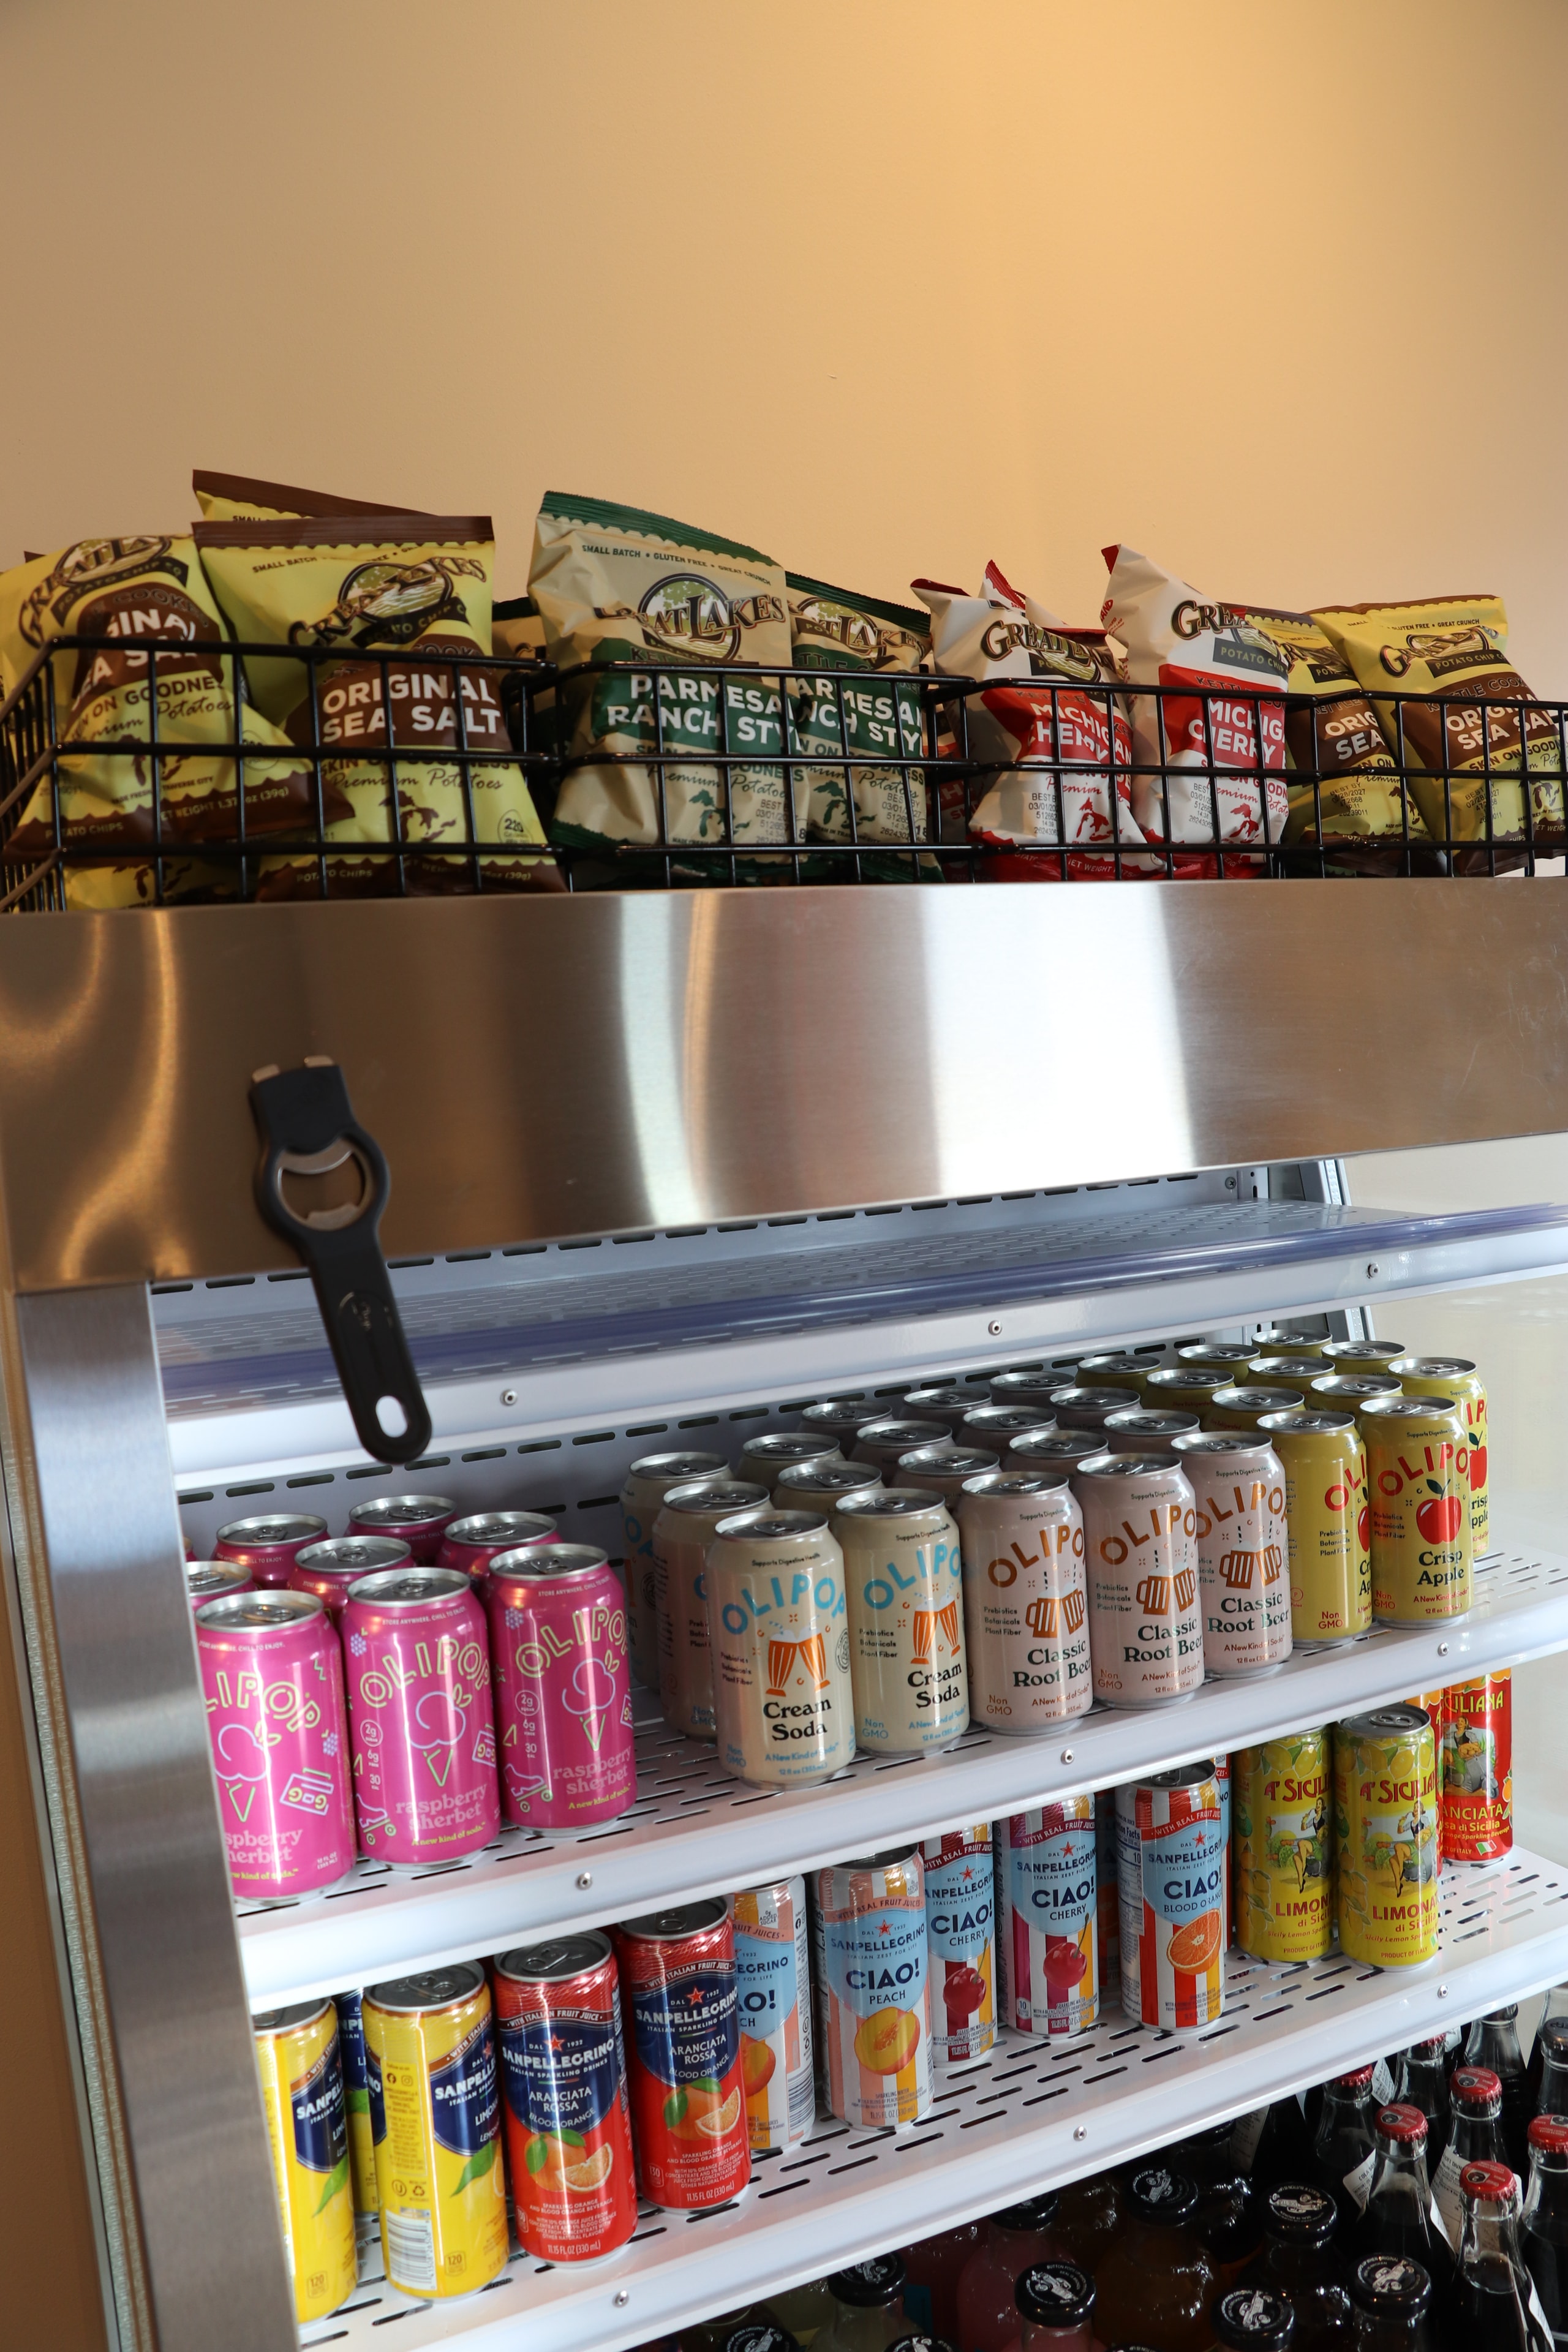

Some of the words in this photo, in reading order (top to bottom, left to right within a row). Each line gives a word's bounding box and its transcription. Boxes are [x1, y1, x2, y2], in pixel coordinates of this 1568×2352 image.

[252, 562, 284, 573] SMALL
[582, 545, 610, 555] SMALL
[612, 548, 641, 558] BATCH
[654, 552, 686, 564] GLUTEN
[687, 558, 708, 567] FREE
[718, 565, 742, 575] GREAT
[744, 571, 771, 586] CRUNCH
[686, 594, 786, 644] LAKES
[980, 620, 1065, 661] GREAT
[1221, 646, 1264, 664] POTATO
[1268, 658, 1285, 673] CHIP
[1434, 655, 1474, 671] POTATO
[322, 673, 497, 714] ORIGINAL
[323, 707, 396, 743] SEA
[411, 705, 501, 734] SALT
[608, 705, 720, 736] RANCH
[1208, 697, 1284, 741] MICHIG
[1336, 729, 1385, 760] SEA
[761, 799, 782, 809] BEST
[45, 825, 86, 839] PTATO
[89, 822, 123, 834] CHIPS
[504, 818, 524, 833] 220
[1320, 1538, 1351, 1547] Botanicals
[1419, 1550, 1462, 1566] Crisp
[1417, 1566, 1464, 1587] Apple
[722, 1574, 845, 1635] OLIPOP
[1221, 1593, 1283, 1613] Classic
[1374, 1599, 1396, 1610] GMO
[1376, 1590, 1392, 1600] Non
[1208, 1617, 1255, 1633] Root
[1261, 1609, 1289, 1629] Beer
[1318, 1619, 1343, 1629] GMO
[1322, 1611, 1339, 1620] Non
[1137, 1618, 1197, 1642] Classic
[1027, 1640, 1086, 1665] Classic
[1123, 1645, 1172, 1662] Root
[1178, 1634, 1202, 1656] Beer
[360, 1638, 489, 1709] OLIPOP
[907, 1663, 962, 1687] Cream
[1013, 1668, 1063, 1687] Root
[1068, 1657, 1091, 1680] Beer
[1101, 1669, 1118, 1679] Non
[1098, 1679, 1122, 1690] GMO
[521, 1694, 533, 1707] 2g
[916, 1685, 960, 1709] Soda
[989, 1695, 1007, 1705] Non
[763, 1698, 832, 1719] Cream
[987, 1705, 1012, 1715] GMO
[522, 1719, 535, 1732] 6g
[772, 1721, 827, 1741] Soda
[865, 1718, 884, 1728] Non
[862, 1728, 889, 1740] GMO
[367, 1749, 379, 1763] 6g
[525, 1743, 537, 1753] 30
[553, 1746, 631, 1780] raspberry
[369, 1774, 381, 1785] 30
[566, 1764, 628, 1795] sherbet
[395, 1784, 488, 1815] raspberry
[409, 1802, 481, 1831] sherbet
[1155, 1823, 1175, 1835] WITH
[1176, 1815, 1195, 1828] REAL
[1196, 1811, 1212, 1819] FRUIT
[1459, 1822, 1467, 1831] di
[1470, 1820, 1500, 1831] Sicilia
[1164, 1864, 1221, 1900] CIAO!
[1031, 1875, 1095, 1909] CIAO!
[837, 1909, 854, 1920] WITH
[858, 1904, 877, 1914] REAL
[930, 1898, 992, 1934] CIAO!
[1050, 1904, 1087, 1920] CHERRY
[1409, 1912, 1436, 1931] Sicilia
[831, 1922, 925, 1951] SANPELLEGRINO
[949, 1928, 986, 1946] CHERRY
[1287, 1930, 1311, 1939] Lemon
[649, 1975, 665, 1988] WITH
[666, 1965, 696, 1980] ITALIAN
[698, 1962, 716, 1970] FRUIT
[846, 1957, 920, 1990] CIAO!
[706, 1989, 720, 1999] 1932
[869, 1989, 906, 2005] PEACH
[636, 1986, 738, 2024] SANPELLEGRINO
[510, 2017, 525, 2027] WITH
[524, 2010, 554, 2022] ITALIAN
[579, 2011, 599, 2021] JUICE
[679, 2018, 718, 2032] SPARKLING
[719, 2005, 736, 2021] DRINKS
[567, 2040, 583, 2048] 1932
[669, 2034, 726, 2056] ARANCIATA
[502, 2038, 614, 2070] SANPELLEGRINO
[684, 2049, 717, 2065] ROSSA
[510, 2065, 534, 2077] ITALIAN
[583, 2058, 608, 2073] DRINKS
[669, 2067, 699, 2079] BLOOD
[700, 2052, 730, 2077] ORANGE
[449, 2092, 477, 2107] ITALIAN
[529, 2086, 592, 2102] ARANCIATA
[543, 2100, 579, 2113] ROSSA
[529, 2112, 557, 2128] BLOOD
[560, 2107, 596, 2128] ORANGE
[682, 2150, 711, 2158] SPARKLING
[712, 2141, 732, 2152] ORANGE
[1359, 2171, 1370, 2180] COLA
